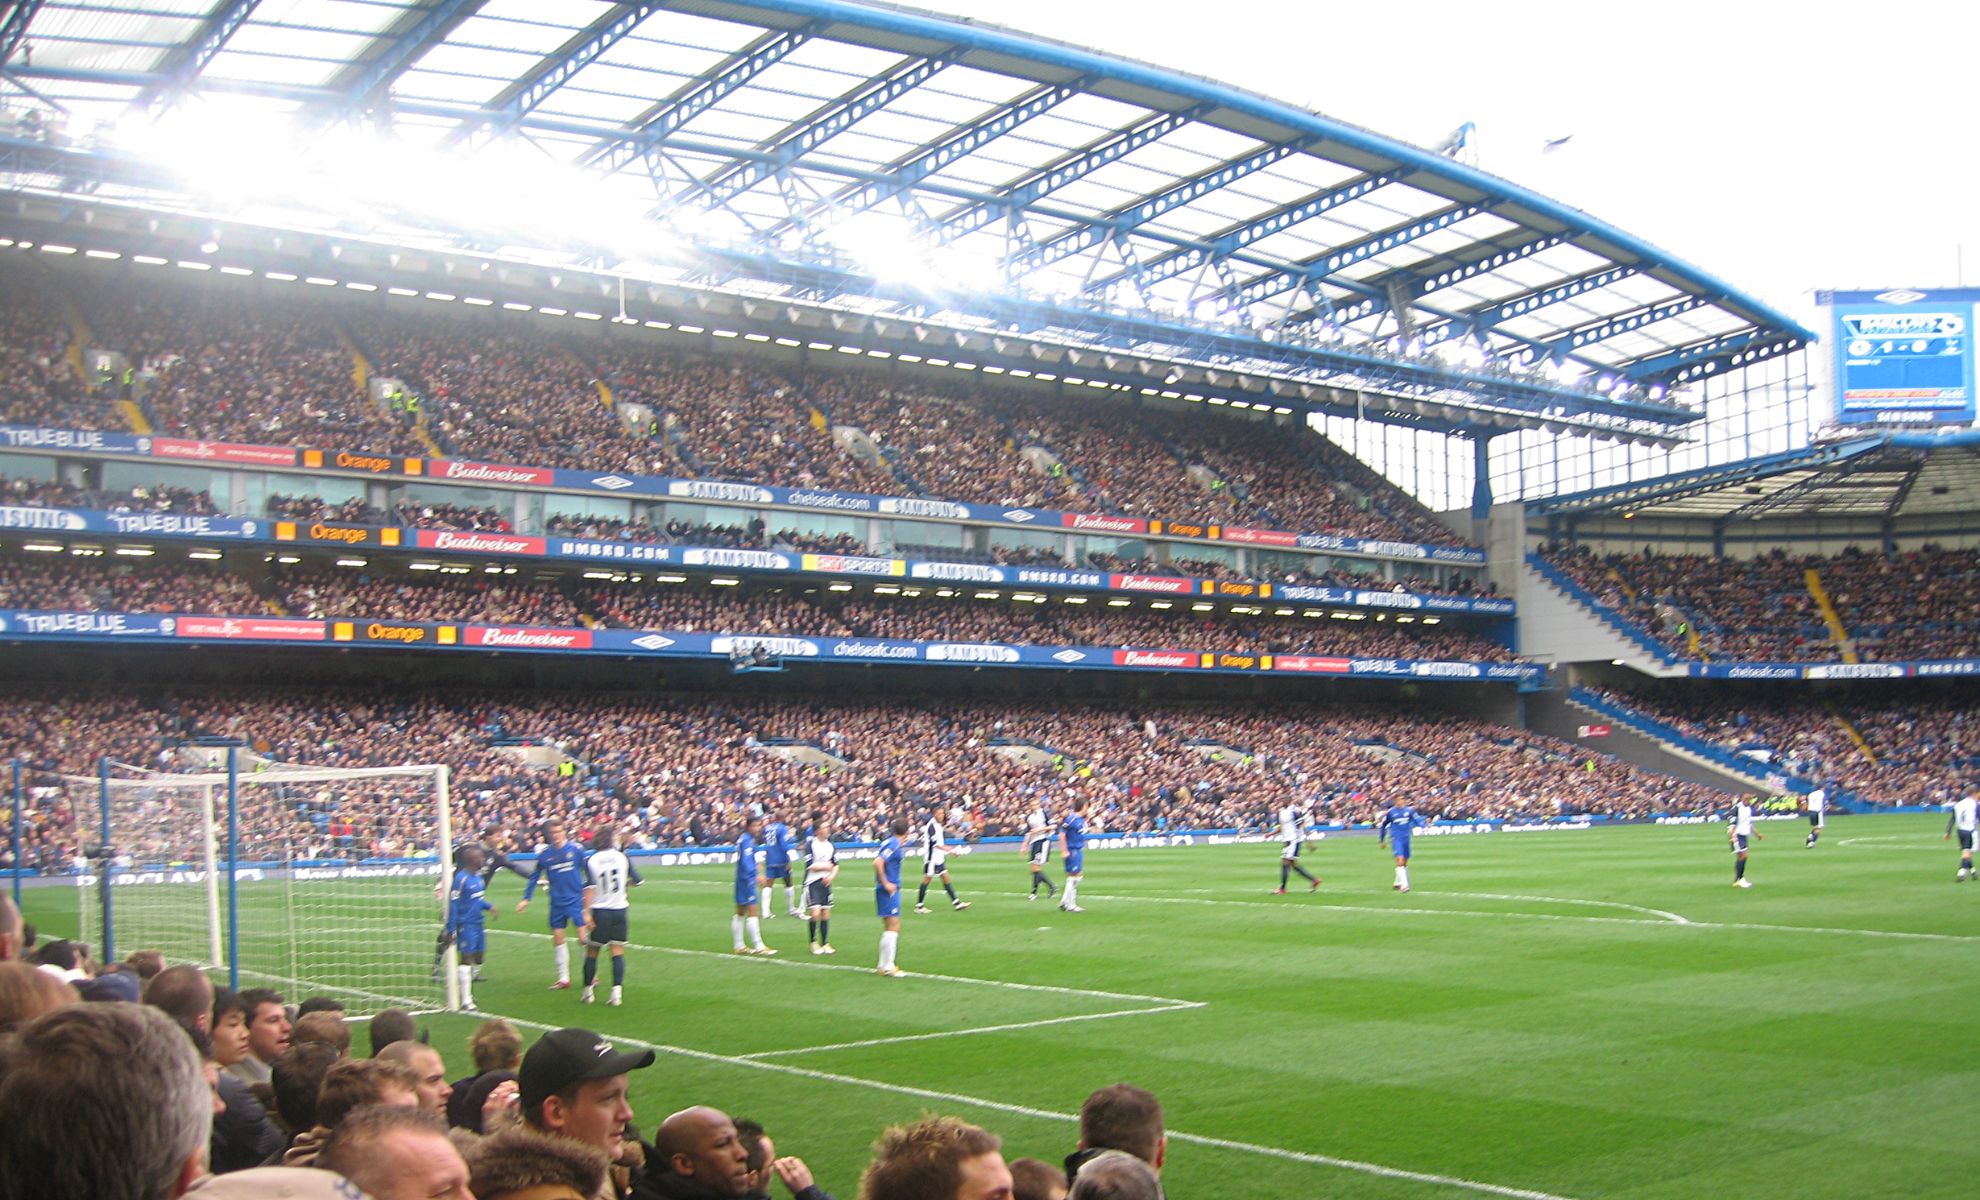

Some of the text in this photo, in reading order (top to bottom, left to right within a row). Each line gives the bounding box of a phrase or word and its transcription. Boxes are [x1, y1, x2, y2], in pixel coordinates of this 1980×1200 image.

[336, 452, 392, 472] Orange
[447, 462, 537, 482] Budweiser
[687, 481, 763, 502] SAMSUNG
[788, 491, 870, 511] chelseafc.com
[895, 499, 961, 518] SAMSUNG
[1073, 514, 1135, 531] Budweiser
[1168, 522, 1202, 537] Orange
[310, 524, 368, 543] Orange
[434, 532, 528, 552] Budweiser
[561, 543, 670, 560] UMBRO.COM
[702, 549, 779, 568] SAMSUNG
[928, 562, 995, 581] SAMSUNG
[1120, 575, 1182, 591] Budweiser
[1219, 581, 1255, 597] Orange
[367, 623, 425, 643] Orange
[482, 628, 575, 647] Budweiser
[730, 637, 808, 656] SAMSUNG
[833, 640, 918, 659] chelseafc.com
[943, 644, 1010, 663] SAMSUNG
[1124, 650, 1186, 668] Budweiser
[1220, 654, 1255, 670] Orange
[1728, 665, 1797, 679] chelseafc.com
[1824, 663, 1892, 679] SAMSUNG
